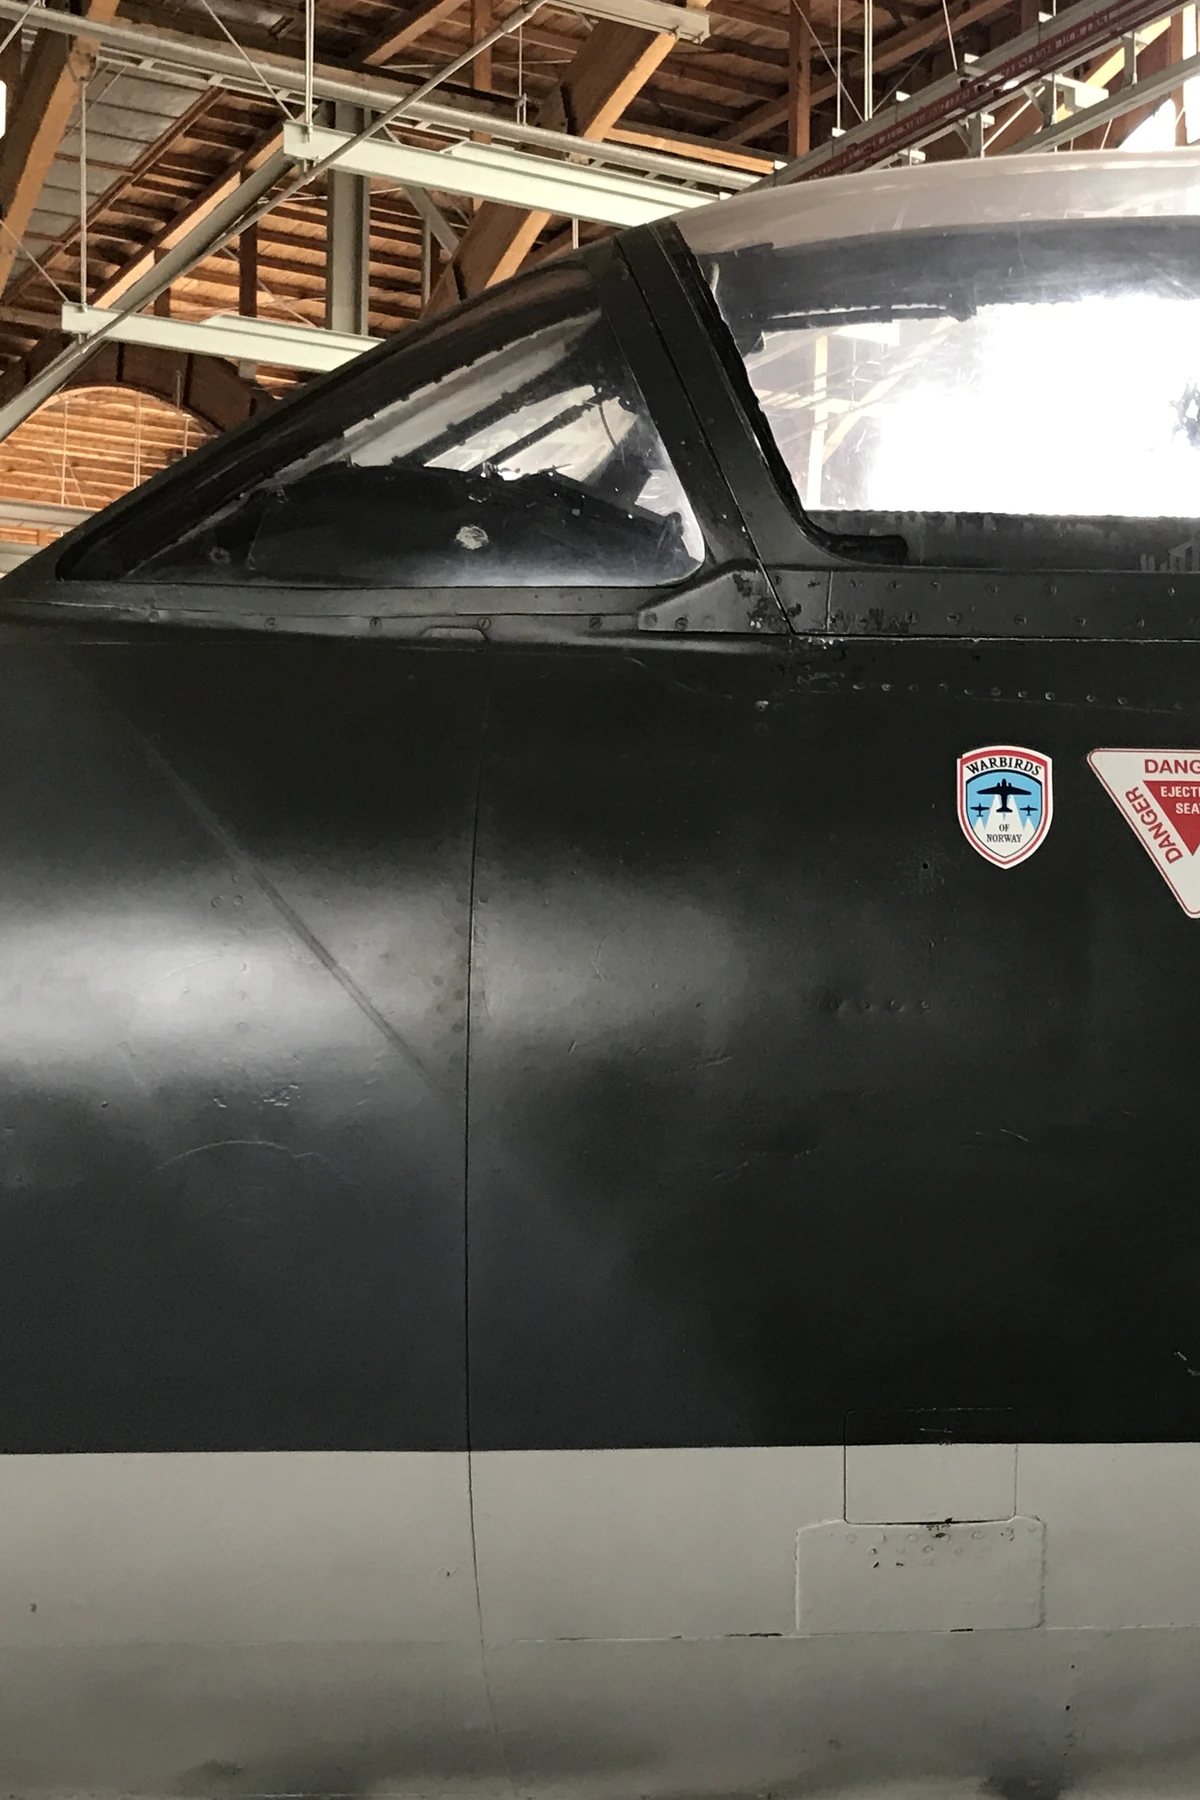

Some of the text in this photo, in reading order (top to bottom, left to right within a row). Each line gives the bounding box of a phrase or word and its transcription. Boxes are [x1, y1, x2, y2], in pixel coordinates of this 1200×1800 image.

[966, 757, 1042, 776] WARBIRDS
[998, 823, 1011, 833] OF
[1125, 786, 1184, 865] DANGER
[986, 834, 1023, 843] NORWAY
